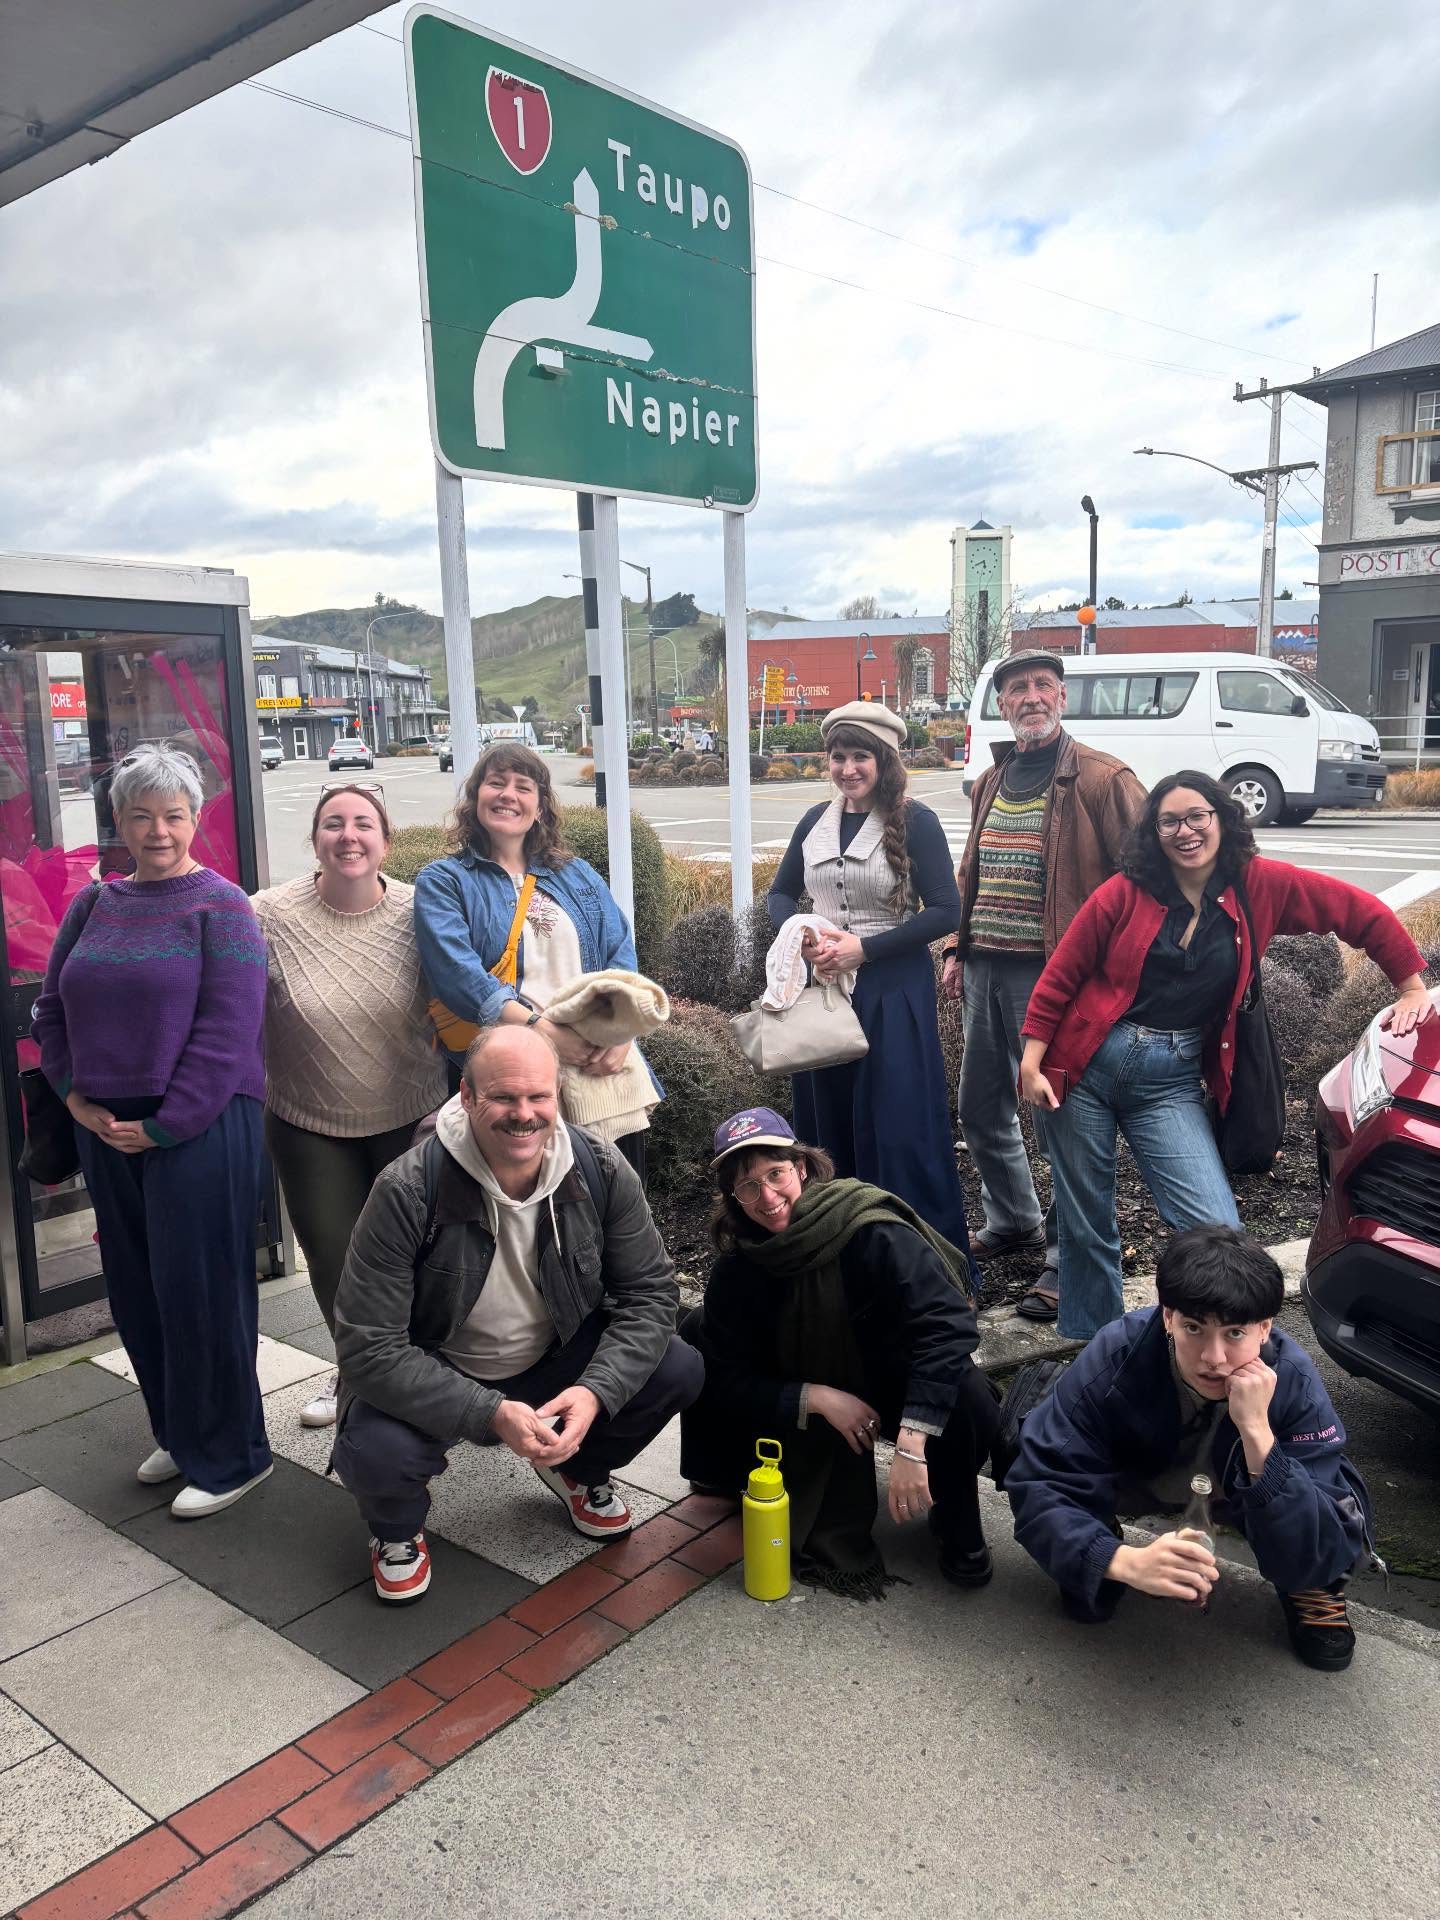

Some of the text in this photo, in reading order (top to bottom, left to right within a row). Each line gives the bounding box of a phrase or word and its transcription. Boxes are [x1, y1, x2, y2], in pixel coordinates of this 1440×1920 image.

[513, 96, 526, 150] 1
[607, 137, 731, 231] Taupo
[606, 377, 740, 446] Napier
[1340, 549, 1409, 575] POST
[796, 684, 830, 699] CLOTHING
[1292, 1432, 1315, 1442] BEST
